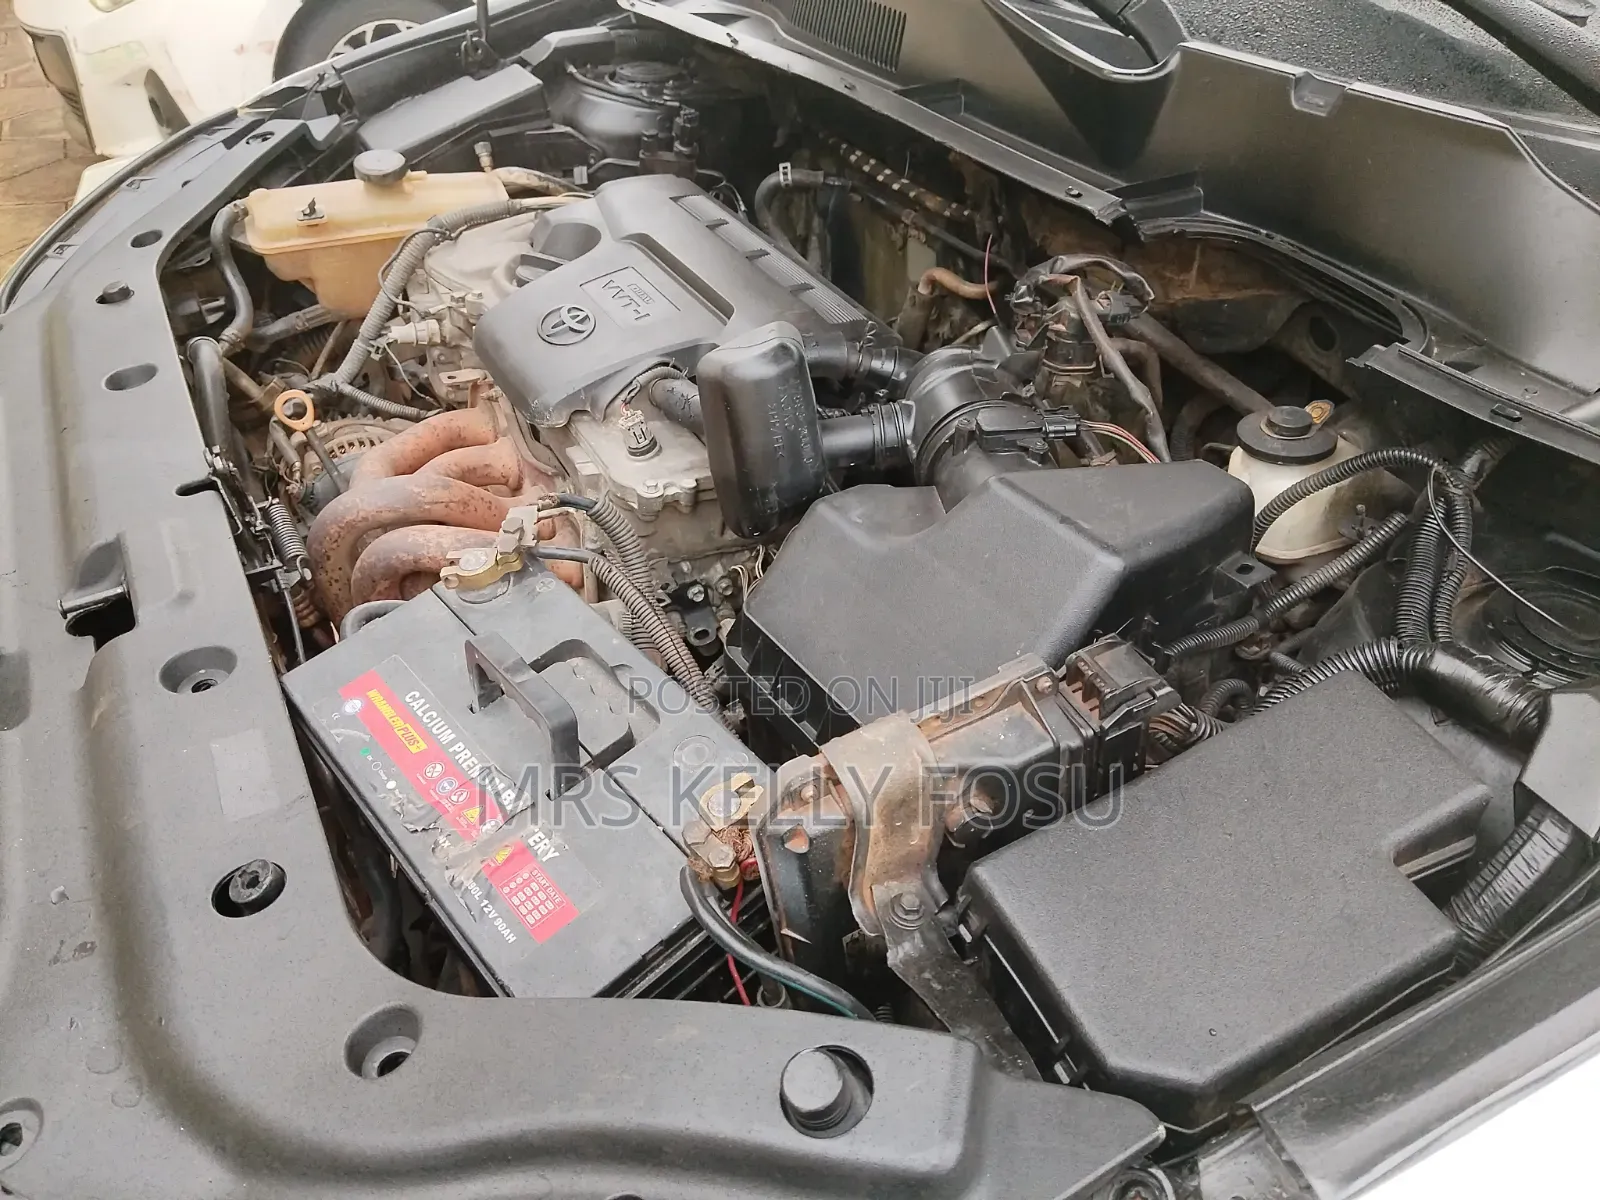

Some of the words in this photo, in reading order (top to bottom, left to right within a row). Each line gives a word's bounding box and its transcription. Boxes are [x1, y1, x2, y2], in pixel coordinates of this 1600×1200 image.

[631, 285, 652, 304] DUAL
[405, 690, 456, 745] CALCIUM
[531, 869, 550, 888] START
[546, 887, 562, 904] DATE
[480, 900, 499, 919] 12V
[493, 917, 517, 944] 90AH
